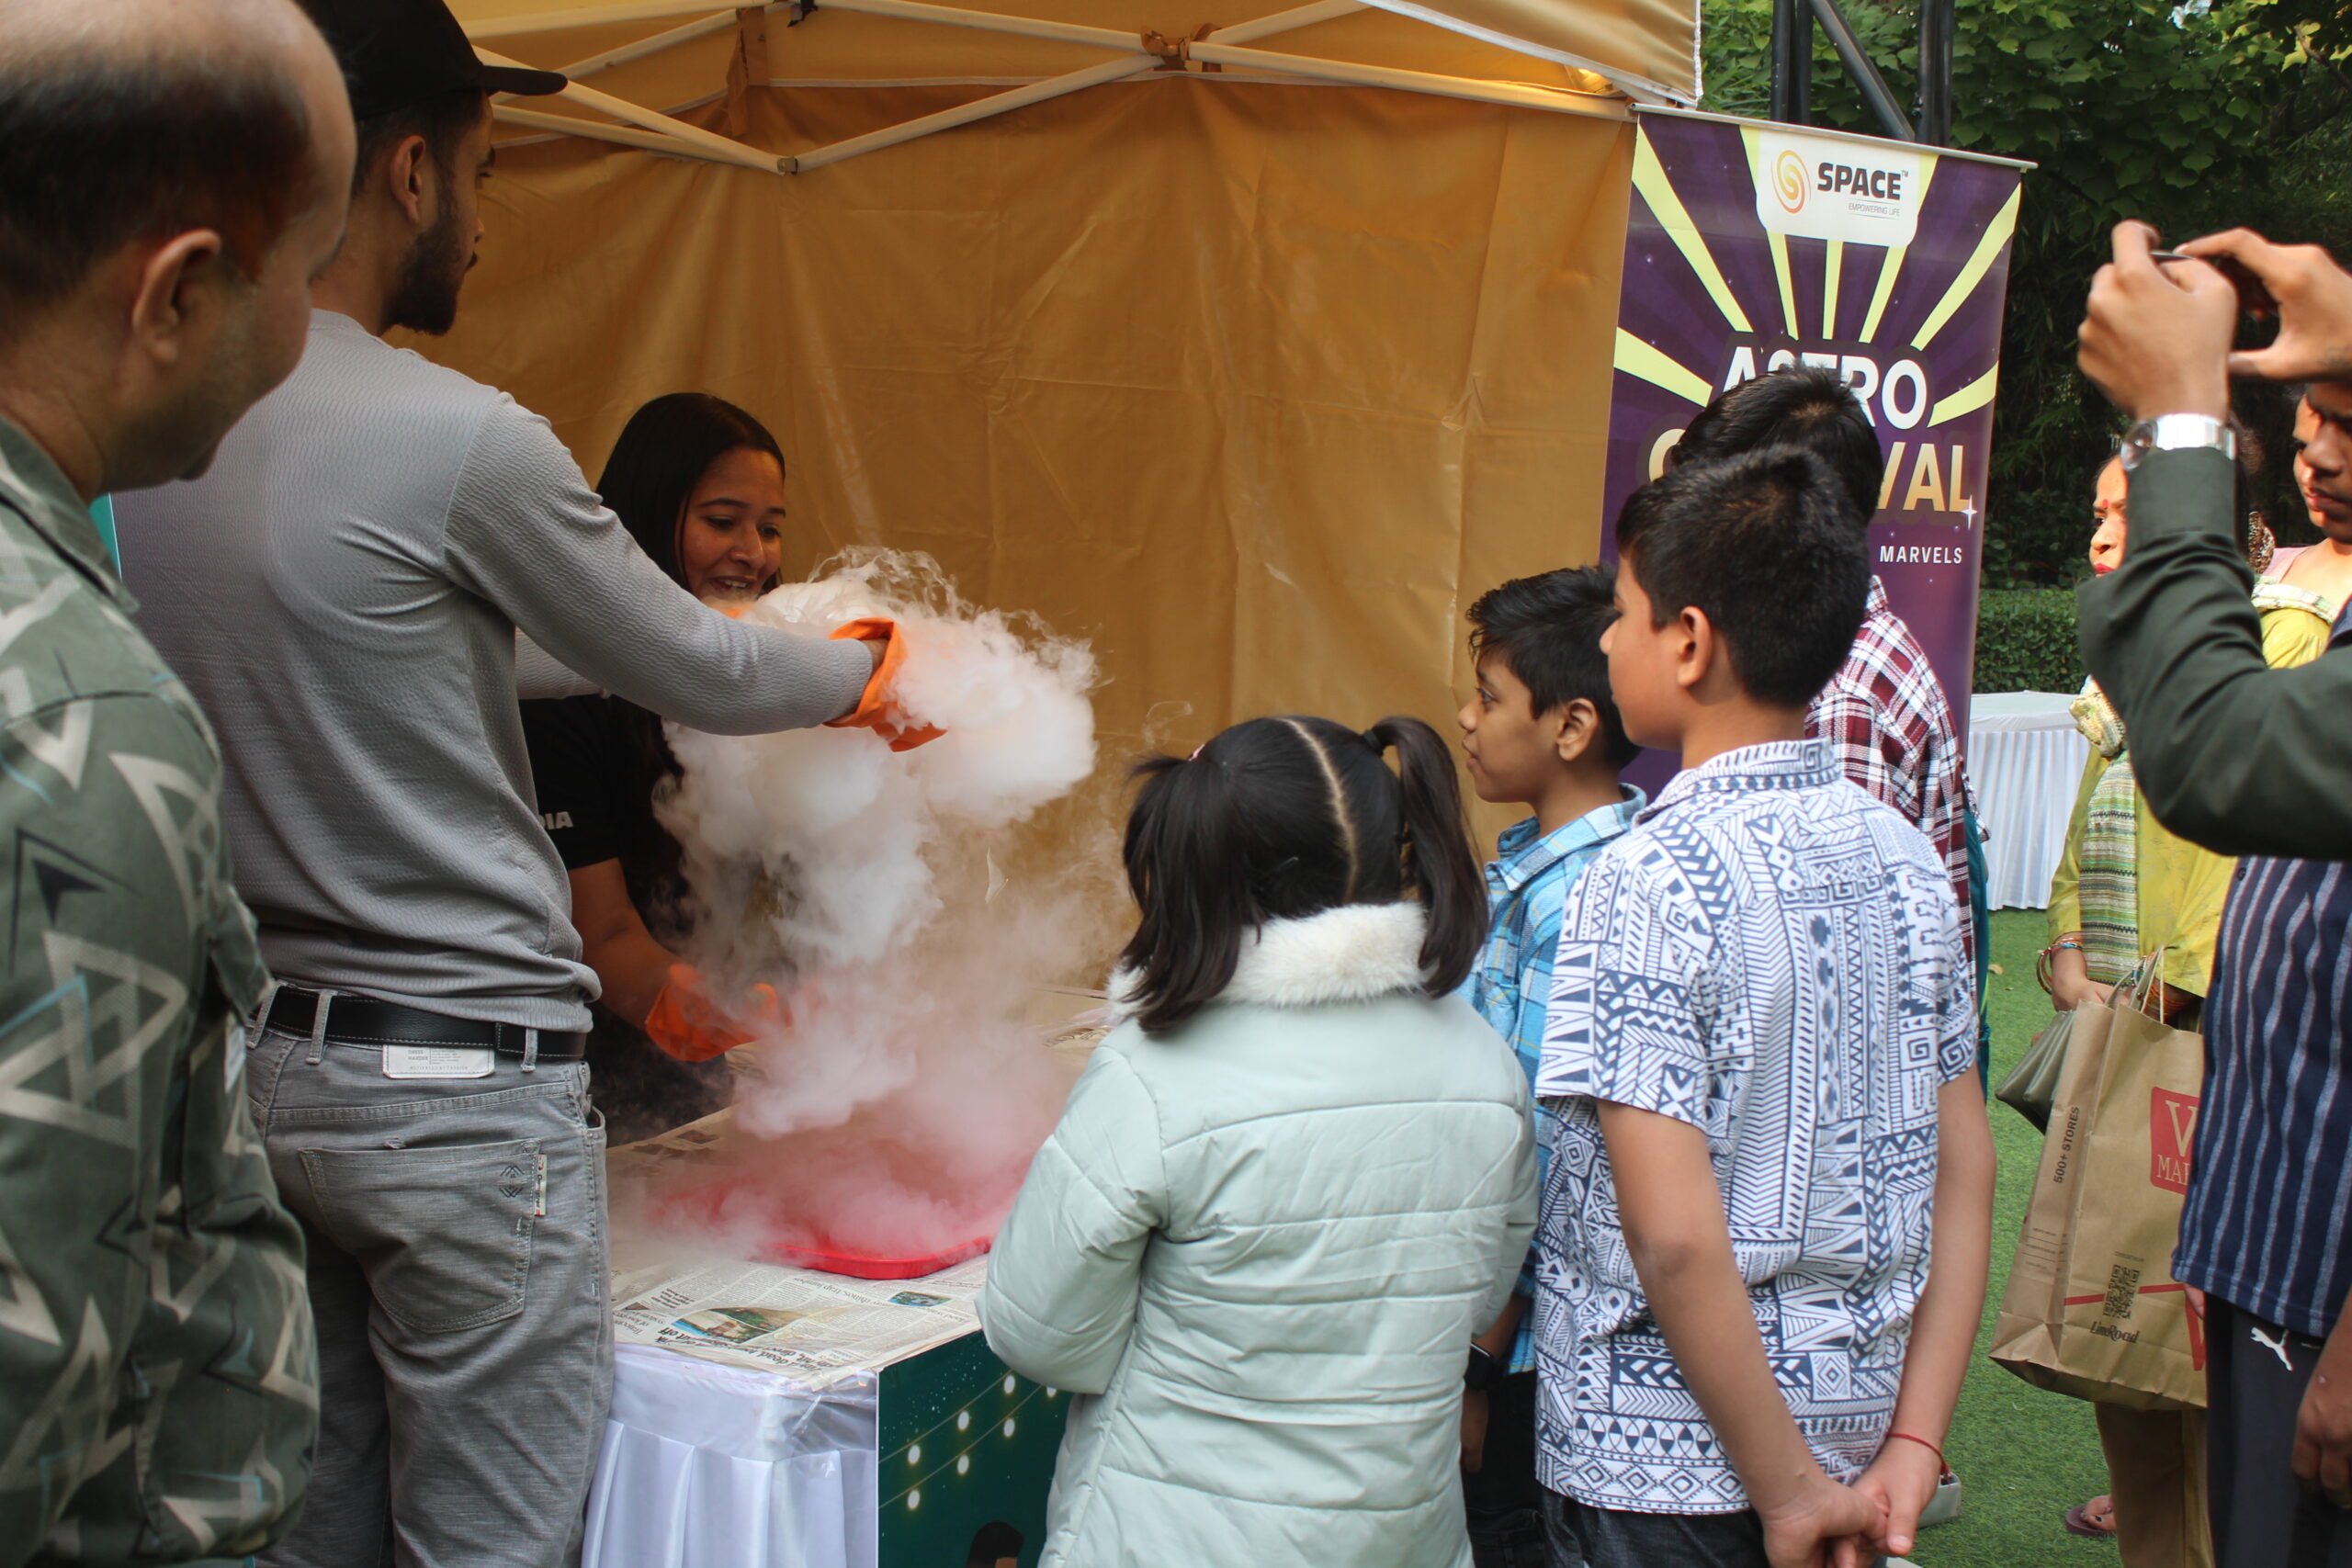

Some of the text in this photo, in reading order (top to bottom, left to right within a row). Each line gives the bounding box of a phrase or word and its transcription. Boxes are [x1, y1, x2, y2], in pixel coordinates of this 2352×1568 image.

[1817, 162, 1901, 200] SPACE
[1849, 203, 1900, 217] EMPOWERING LIFE
[1723, 346, 1927, 429] ARO
[1880, 546, 1962, 564] MARVELS
[2053, 1107, 2079, 1183] 500+ STORES
[2165, 1100, 2198, 1157] V
